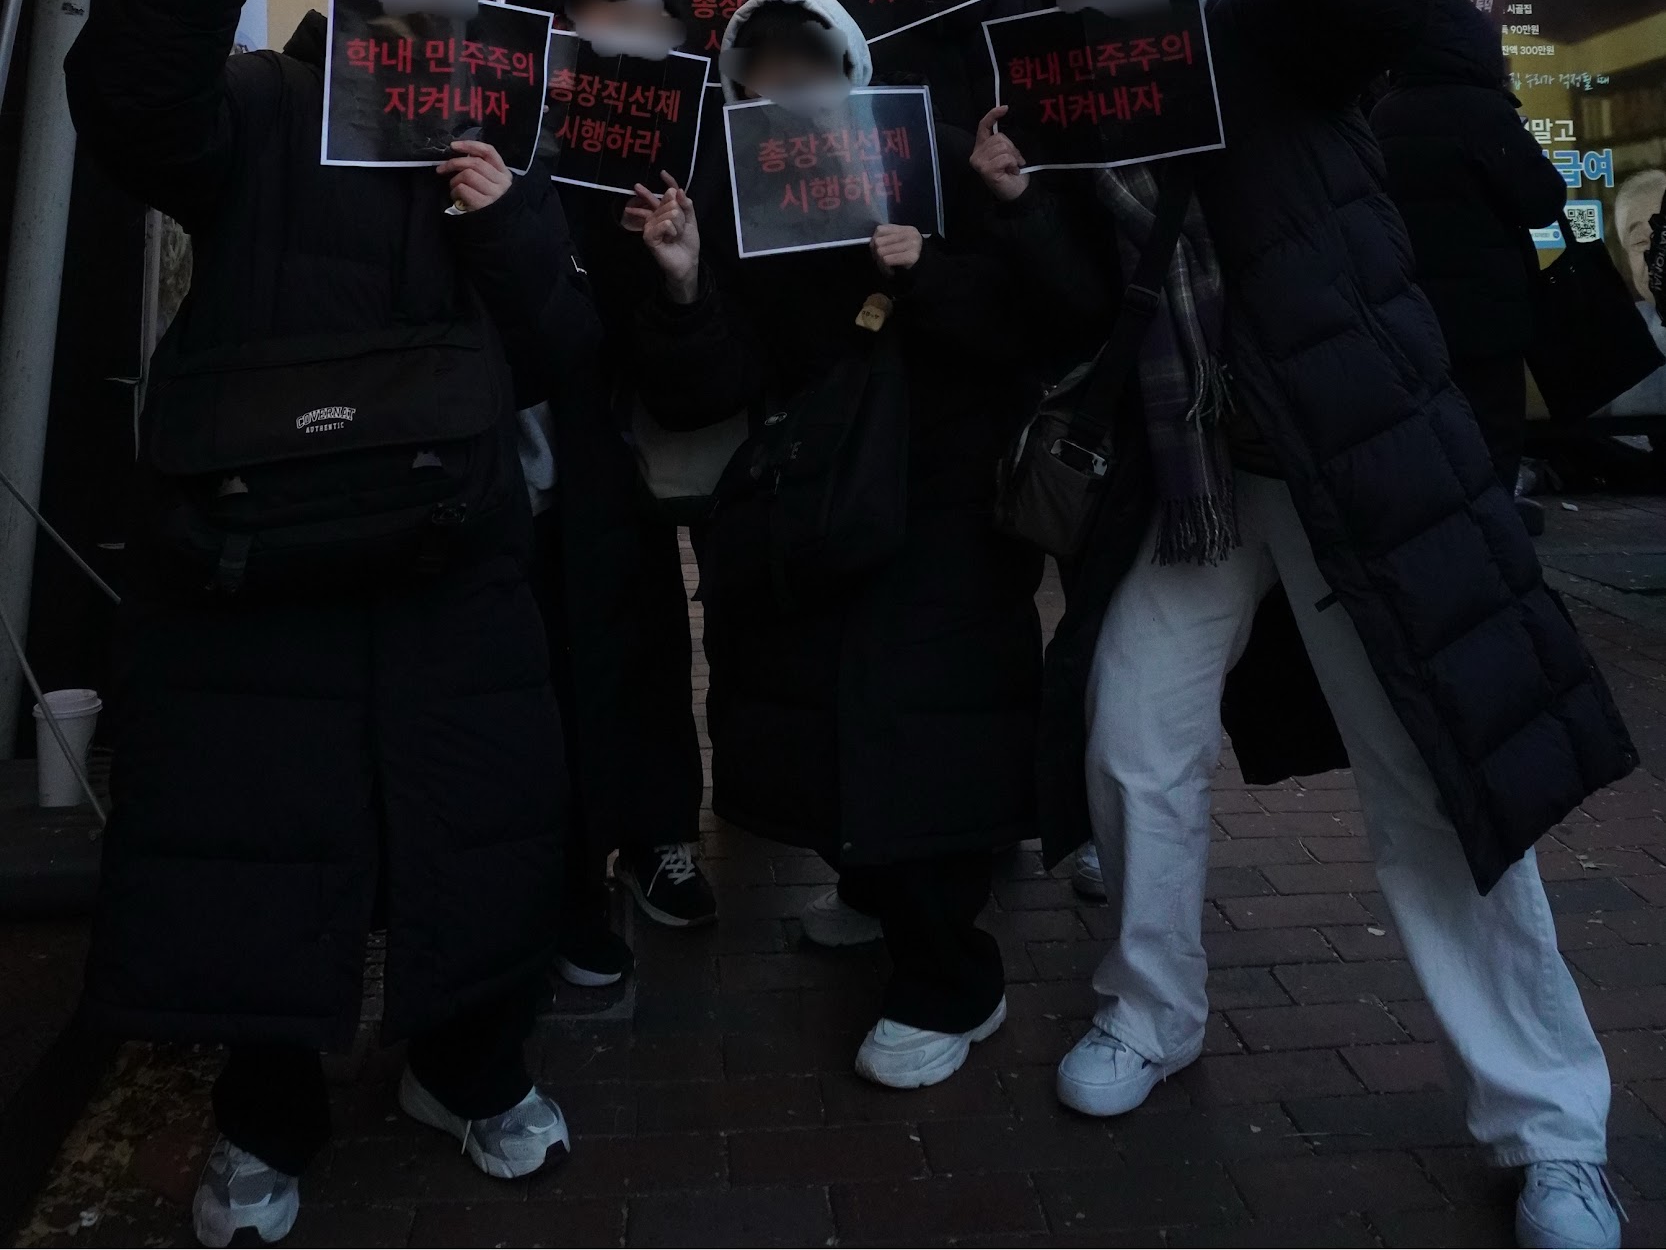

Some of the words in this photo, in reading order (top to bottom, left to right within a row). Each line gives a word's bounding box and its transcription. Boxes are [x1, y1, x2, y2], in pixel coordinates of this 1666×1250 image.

[1507, 3, 1533, 15] 시골집
[1510, 24, 1540, 35] 90만원
[346, 37, 413, 74] 학내
[425, 37, 535, 86] 민주주의
[1007, 50, 1062, 90] 학내
[1067, 29, 1194, 82] 민주주의
[1520, 45, 1555, 56] 300만원
[383, 83, 510, 126] 지켜내자
[547, 68, 682, 123] 총장직선제
[1038, 79, 1164, 128] 지켜내자
[555, 114, 662, 164] 시행하라
[757, 126, 912, 173] 총장직선제
[1524, 118, 1577, 145] 말고
[1541, 148, 1615, 188] 급여
[779, 169, 903, 214] 시행하라
[295, 406, 357, 430] COVERNAT
[305, 421, 345, 434] AUTHENTIC
